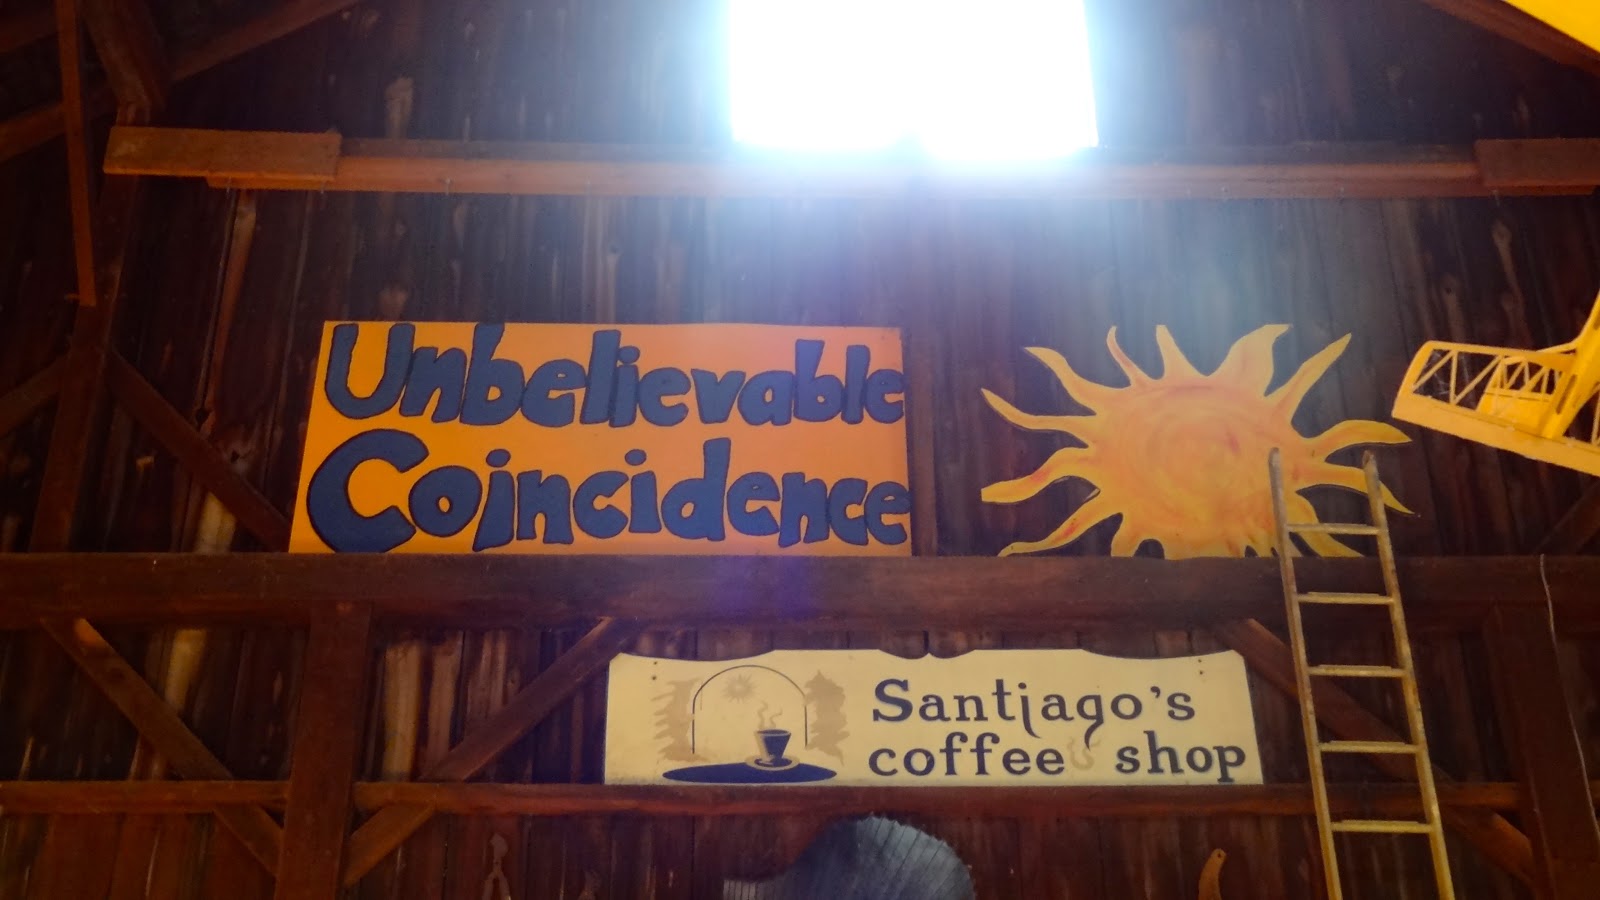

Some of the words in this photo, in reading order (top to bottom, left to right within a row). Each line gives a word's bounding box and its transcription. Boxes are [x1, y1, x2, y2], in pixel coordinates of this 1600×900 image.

[324, 322, 905, 427] Unbelievable
[306, 428, 912, 553] Coincidence
[868, 731, 1065, 776] coffee
[1115, 730, 1246, 783] shop
[872, 678, 1195, 751] Santiago's
